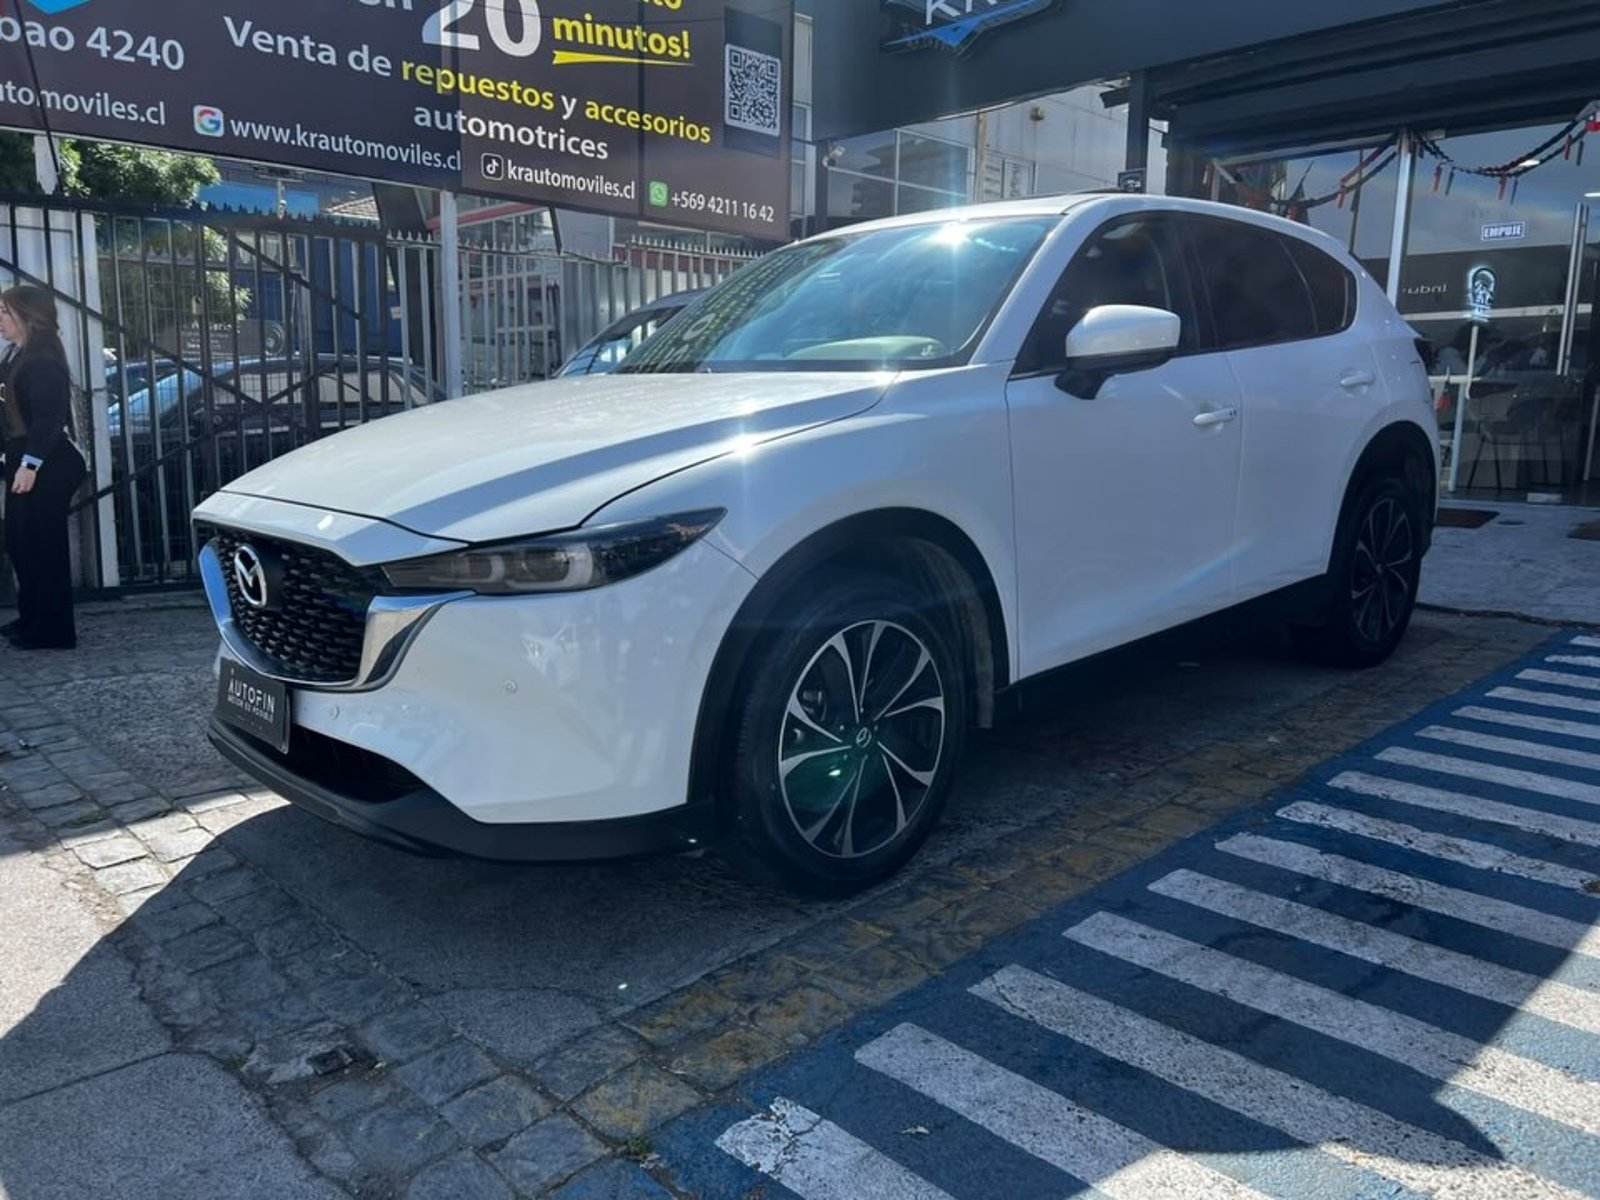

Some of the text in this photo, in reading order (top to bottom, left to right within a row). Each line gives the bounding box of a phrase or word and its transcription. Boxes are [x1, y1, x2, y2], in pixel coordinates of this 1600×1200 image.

[86, 26, 185, 70] 4240
[422, 0, 541, 57] 20
[553, 13, 691, 59] minutos!
[223, 16, 711, 143] Venta de repuestos y accesorios
[0, 80, 166, 126] tomoviles.cl
[230, 119, 462, 171] www.krautomoviles.cl
[414, 106, 609, 159] automotrices
[507, 159, 636, 199] krautomoviles.cl
[671, 190, 705, 211] +569
[707, 195, 738, 216] 4211
